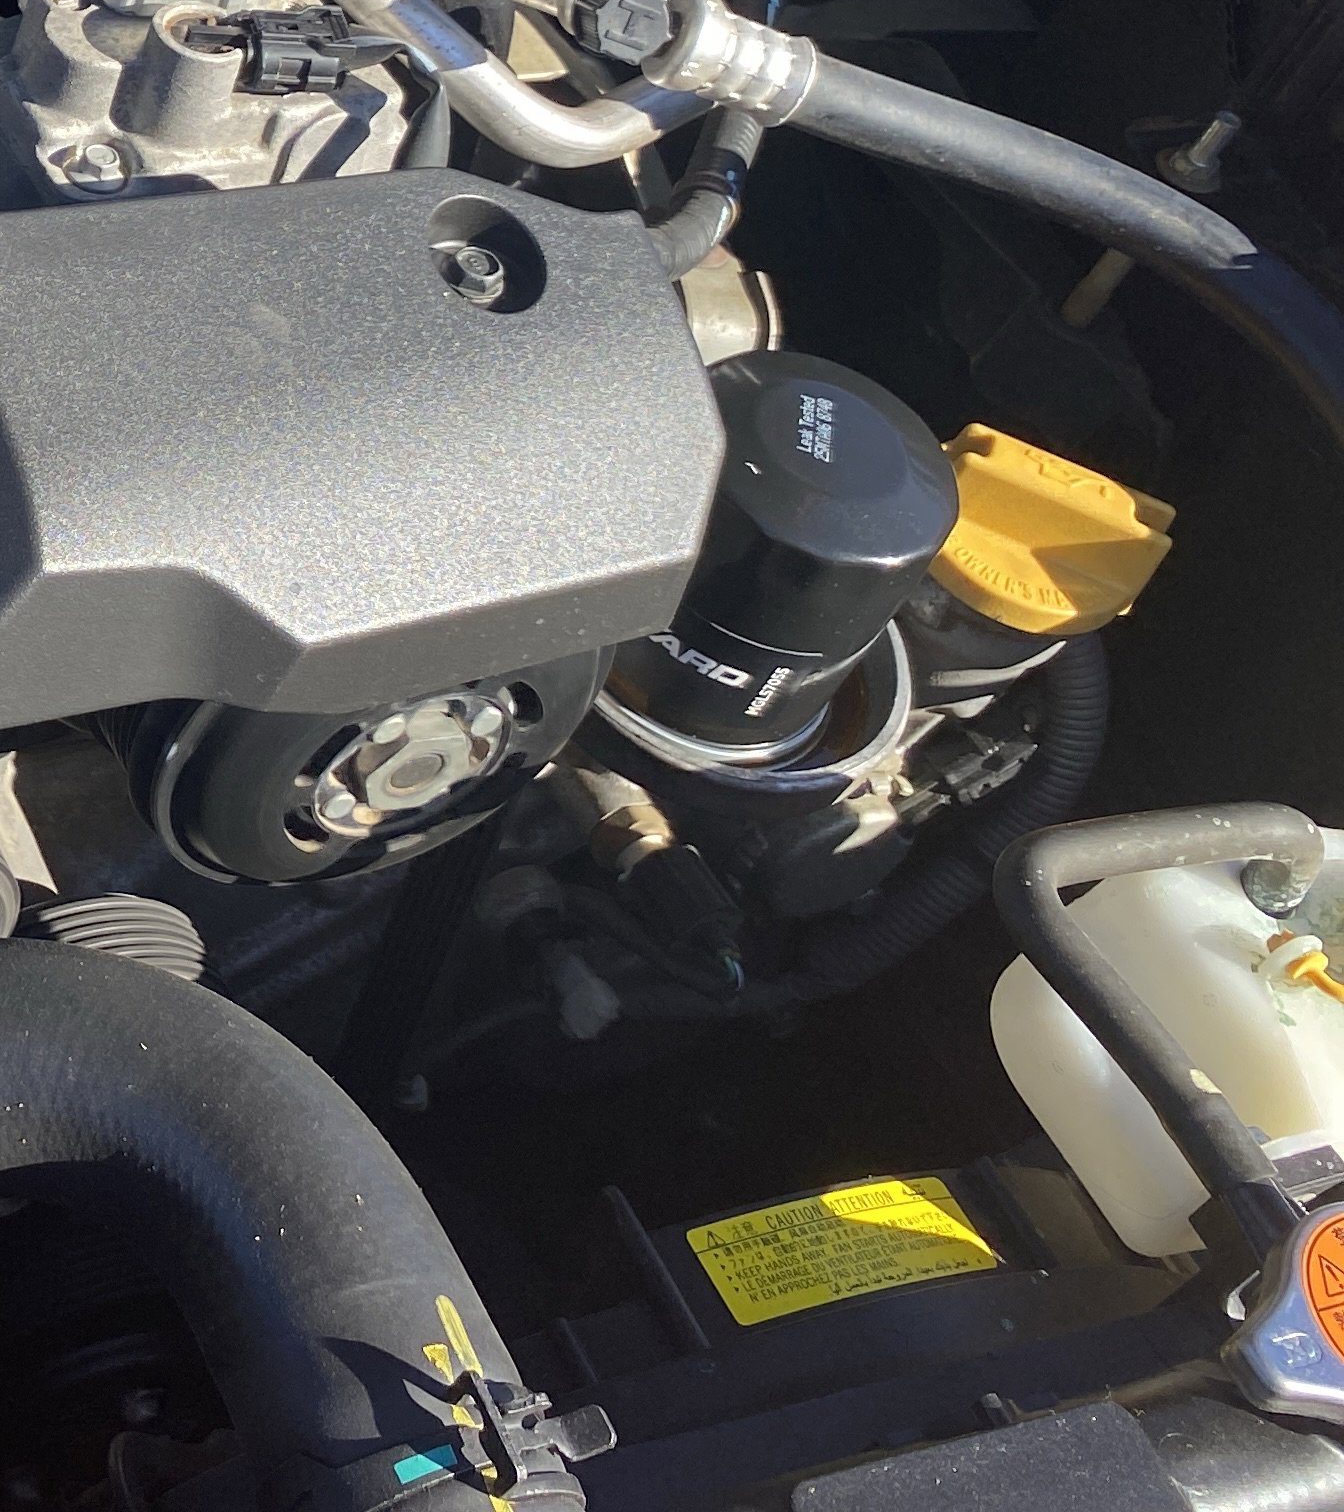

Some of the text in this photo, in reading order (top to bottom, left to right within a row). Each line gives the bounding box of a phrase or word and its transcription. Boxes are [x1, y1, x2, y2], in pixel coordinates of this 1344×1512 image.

[796, 394, 816, 454] Leak Tested
[650, 629, 753, 688] ARD
[765, 1203, 824, 1229] CAUTION
[829, 1190, 895, 1215] ATTENTION
[734, 1265, 762, 1281] KEEP
[764, 1255, 801, 1273] HANDS
[832, 1241, 853, 1255] FAN
[855, 1234, 885, 1250] STARTS
[741, 1279, 756, 1293] LE
[812, 1259, 825, 1272] DU
[779, 1275, 831, 1295] APPROCHEZ
[832, 1269, 851, 1281] PAS
[851, 1263, 870, 1276] LES
